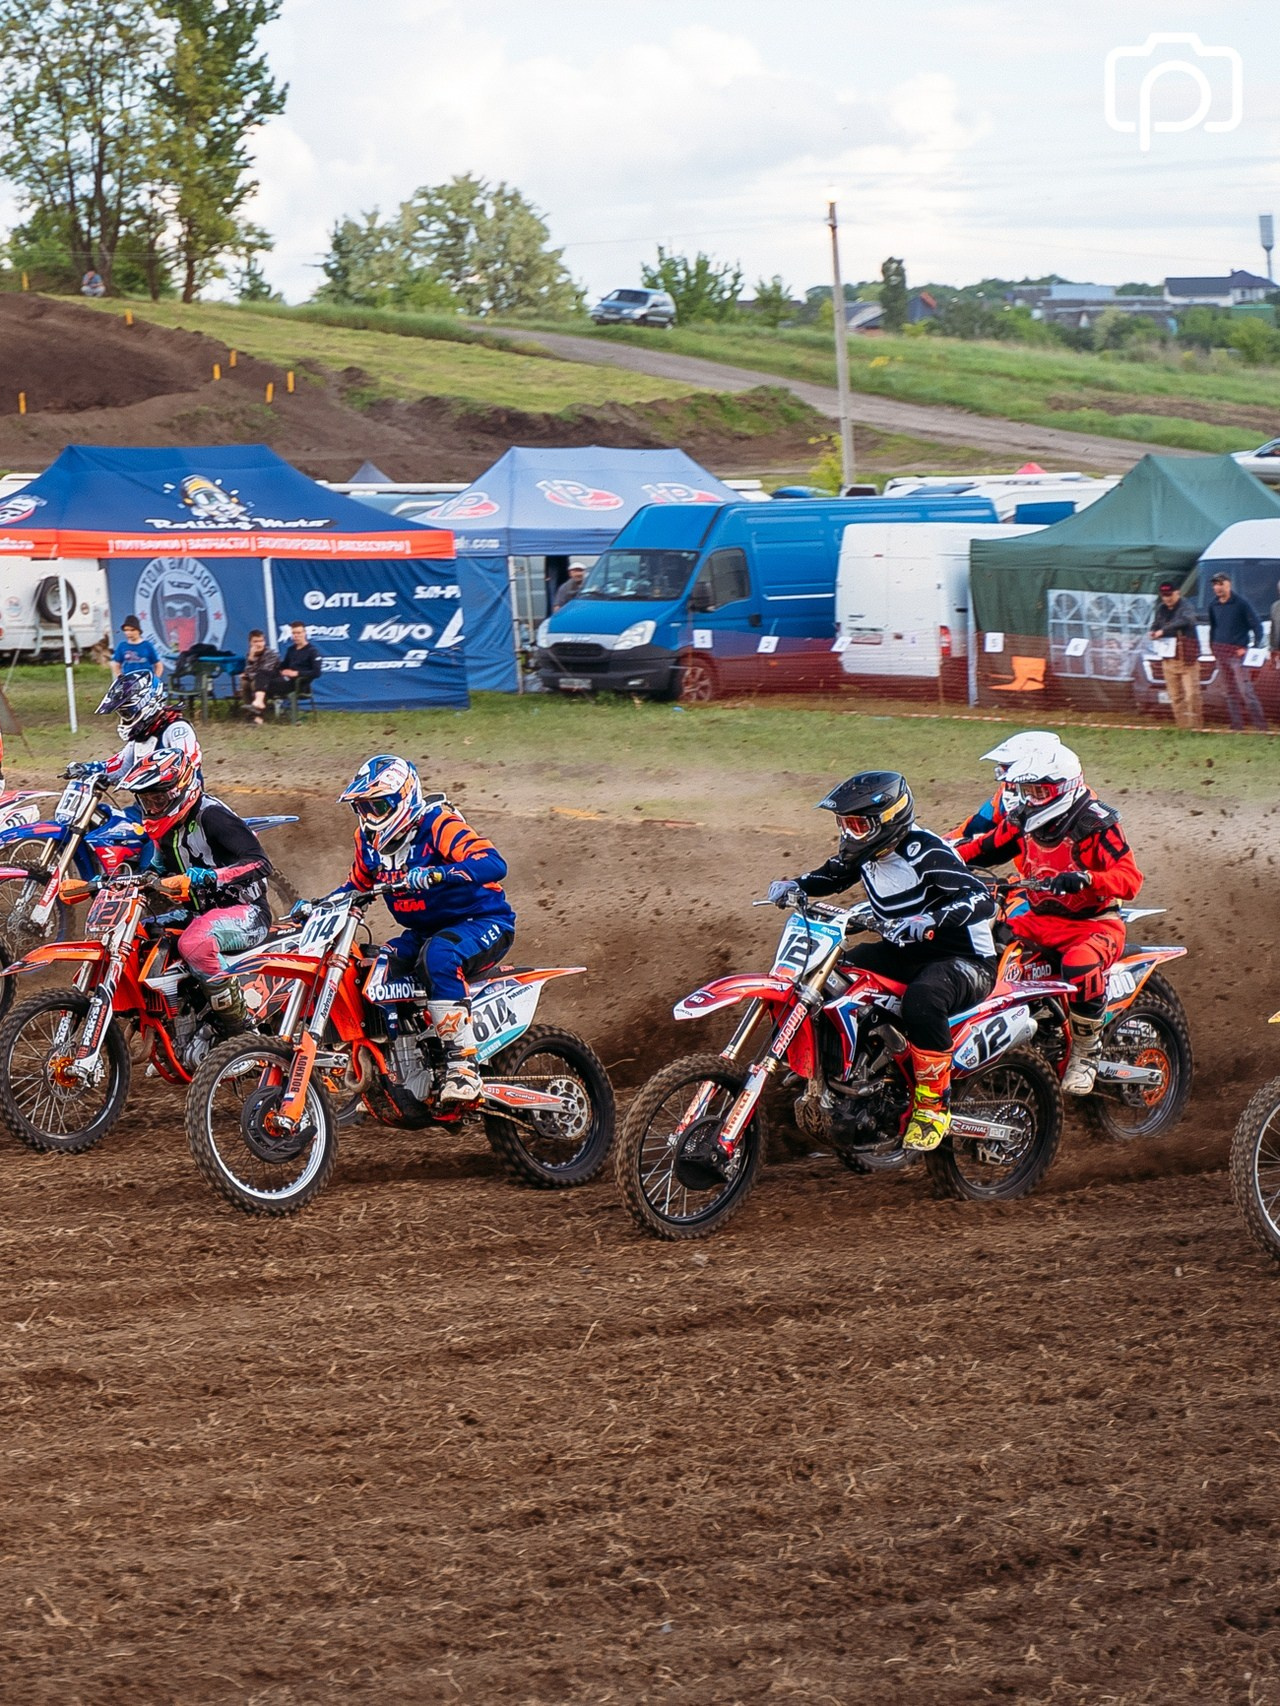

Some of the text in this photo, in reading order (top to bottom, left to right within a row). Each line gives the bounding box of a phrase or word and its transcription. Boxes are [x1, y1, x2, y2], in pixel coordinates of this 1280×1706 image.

[144, 516, 333, 530] Rolling Moto
[324, 592, 397, 608] ATLAS
[358, 614, 434, 645] KAYO
[42, 877, 60, 903] MOTUL
[393, 898, 426, 912] KTM
[301, 915, 341, 947] 814
[778, 933, 821, 967] 12
[1032, 964, 1052, 979] ROAD
[472, 996, 517, 1042] 814
[772, 1003, 808, 1060] SHOWA
[973, 1016, 1011, 1064] 12
[291, 1055, 309, 1093] BOLKHOV
